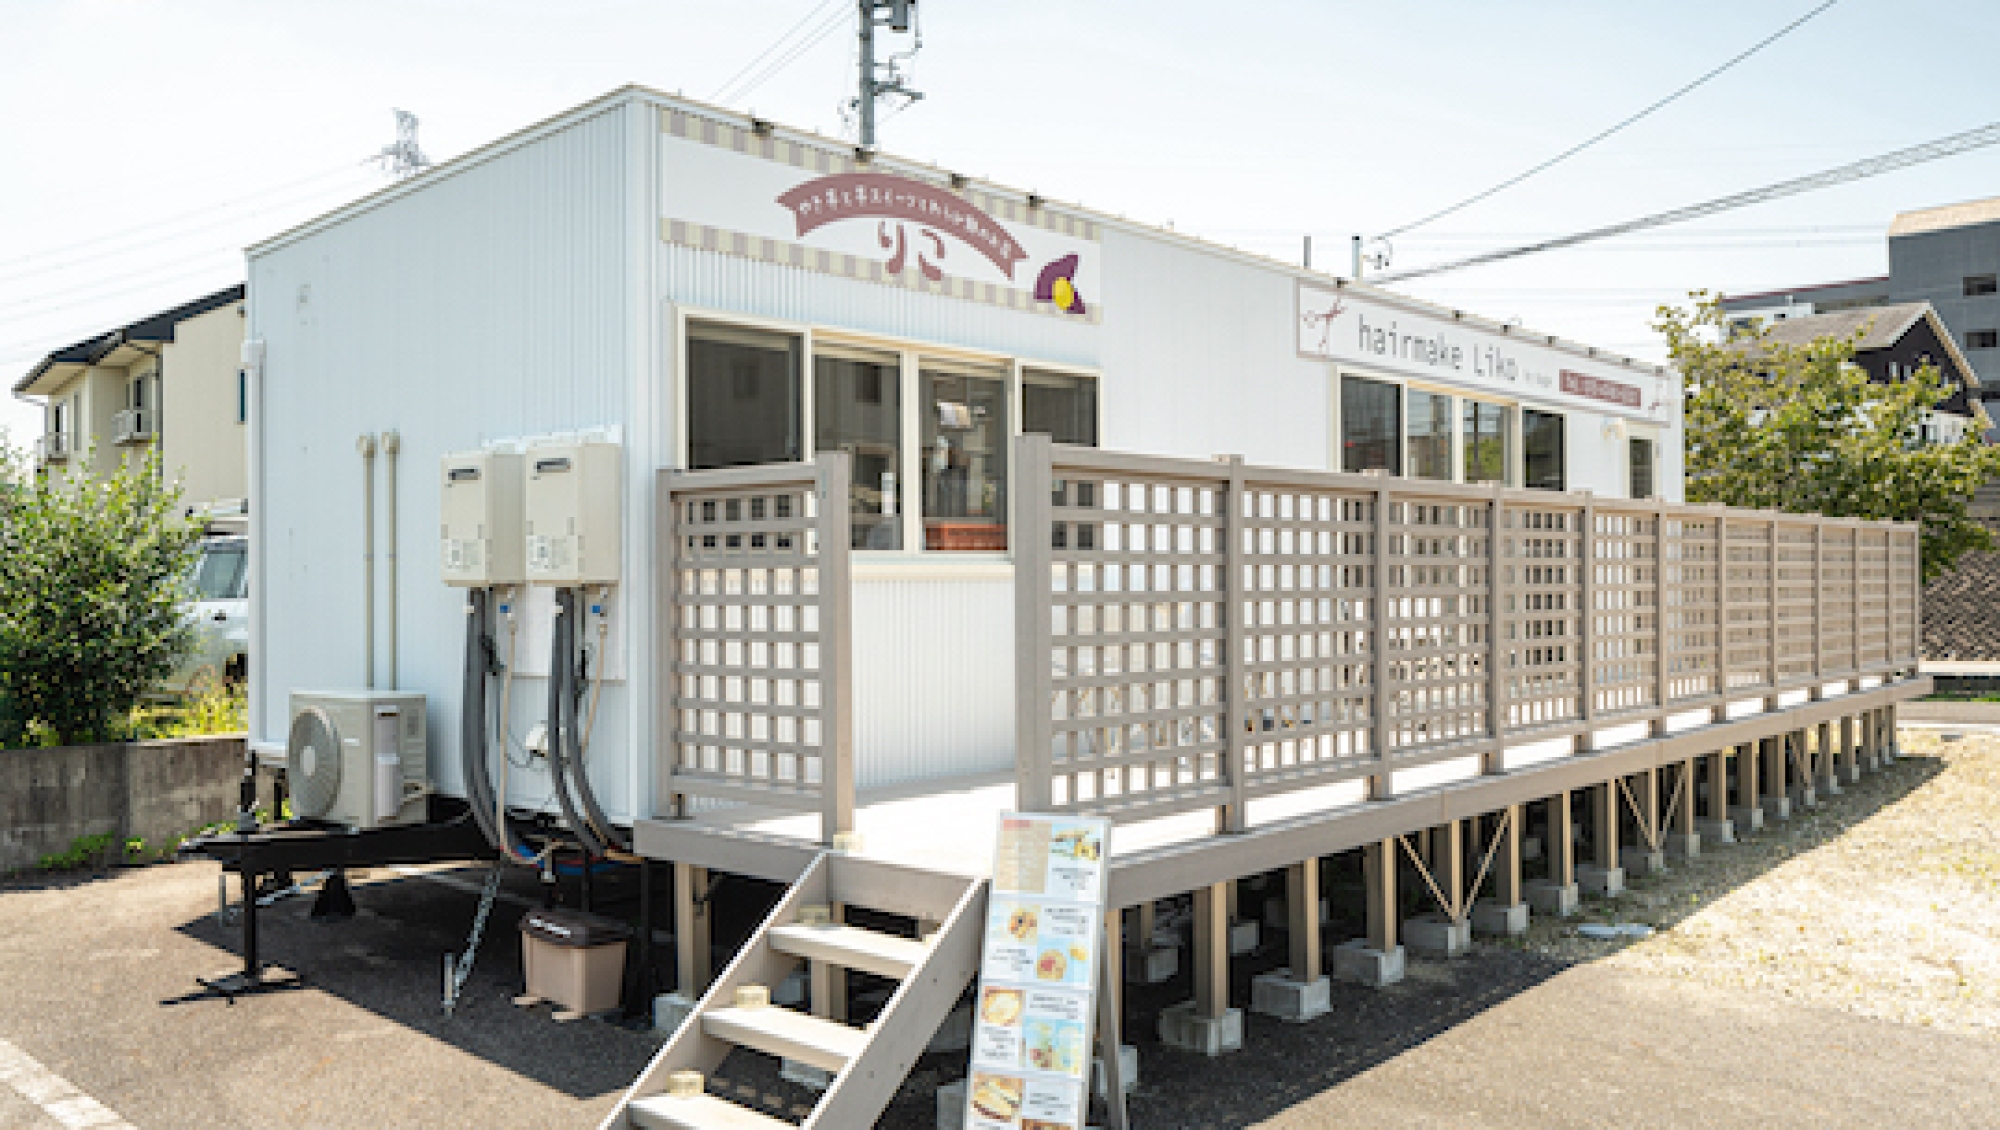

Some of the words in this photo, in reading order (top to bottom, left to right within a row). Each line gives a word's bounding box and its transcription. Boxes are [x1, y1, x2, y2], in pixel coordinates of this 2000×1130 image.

[878, 221, 946, 281] りこ
[1358, 313, 1463, 370] hairmake
[1473, 343, 1519, 381] Liko
